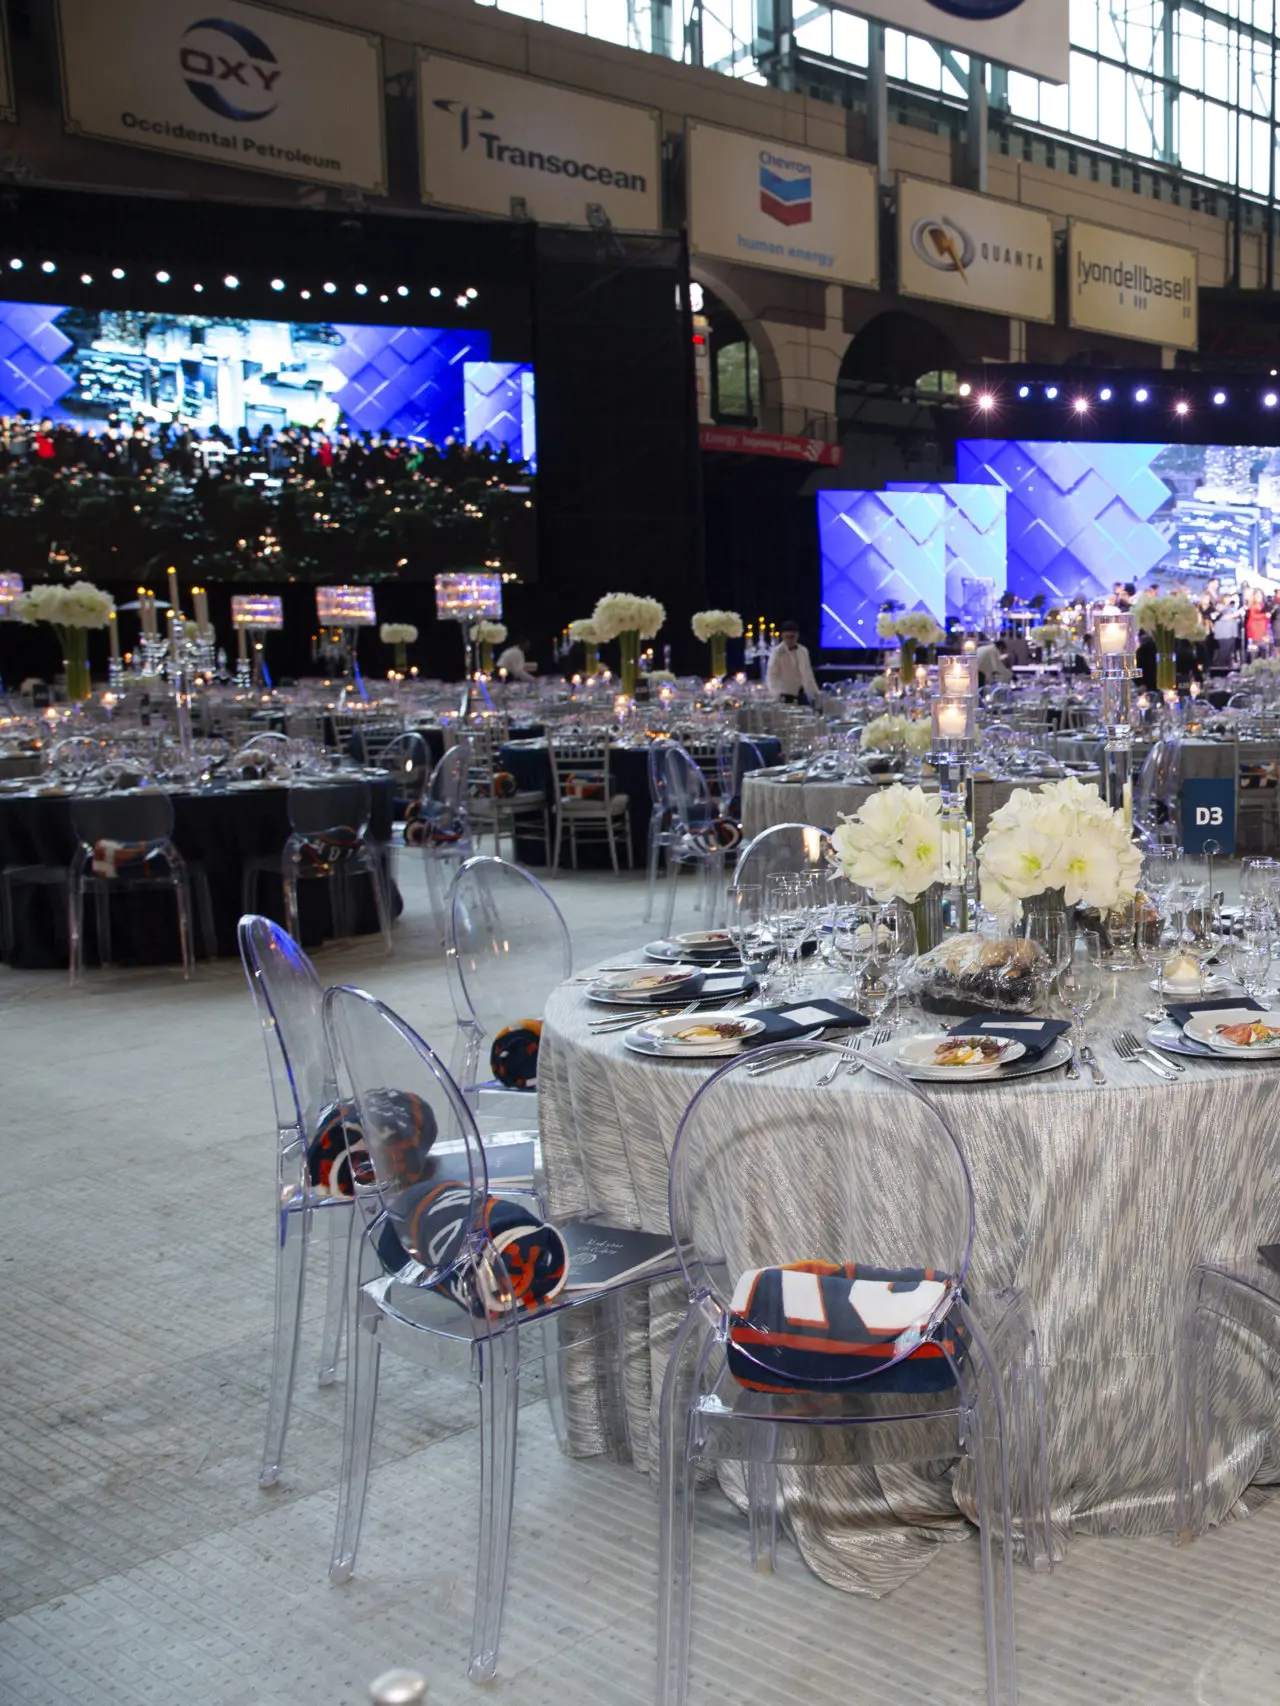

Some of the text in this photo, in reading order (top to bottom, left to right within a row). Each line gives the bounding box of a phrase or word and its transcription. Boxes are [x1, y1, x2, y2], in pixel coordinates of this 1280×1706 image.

[179, 48, 282, 91] OXY
[120, 111, 342, 171] Occidental Petroleum
[478, 131, 647, 193] Transocean
[758, 149, 812, 175] Chevron
[737, 233, 835, 268] human energy
[980, 242, 1044, 273] QUANTA
[1195, 806, 1223, 825] D3
